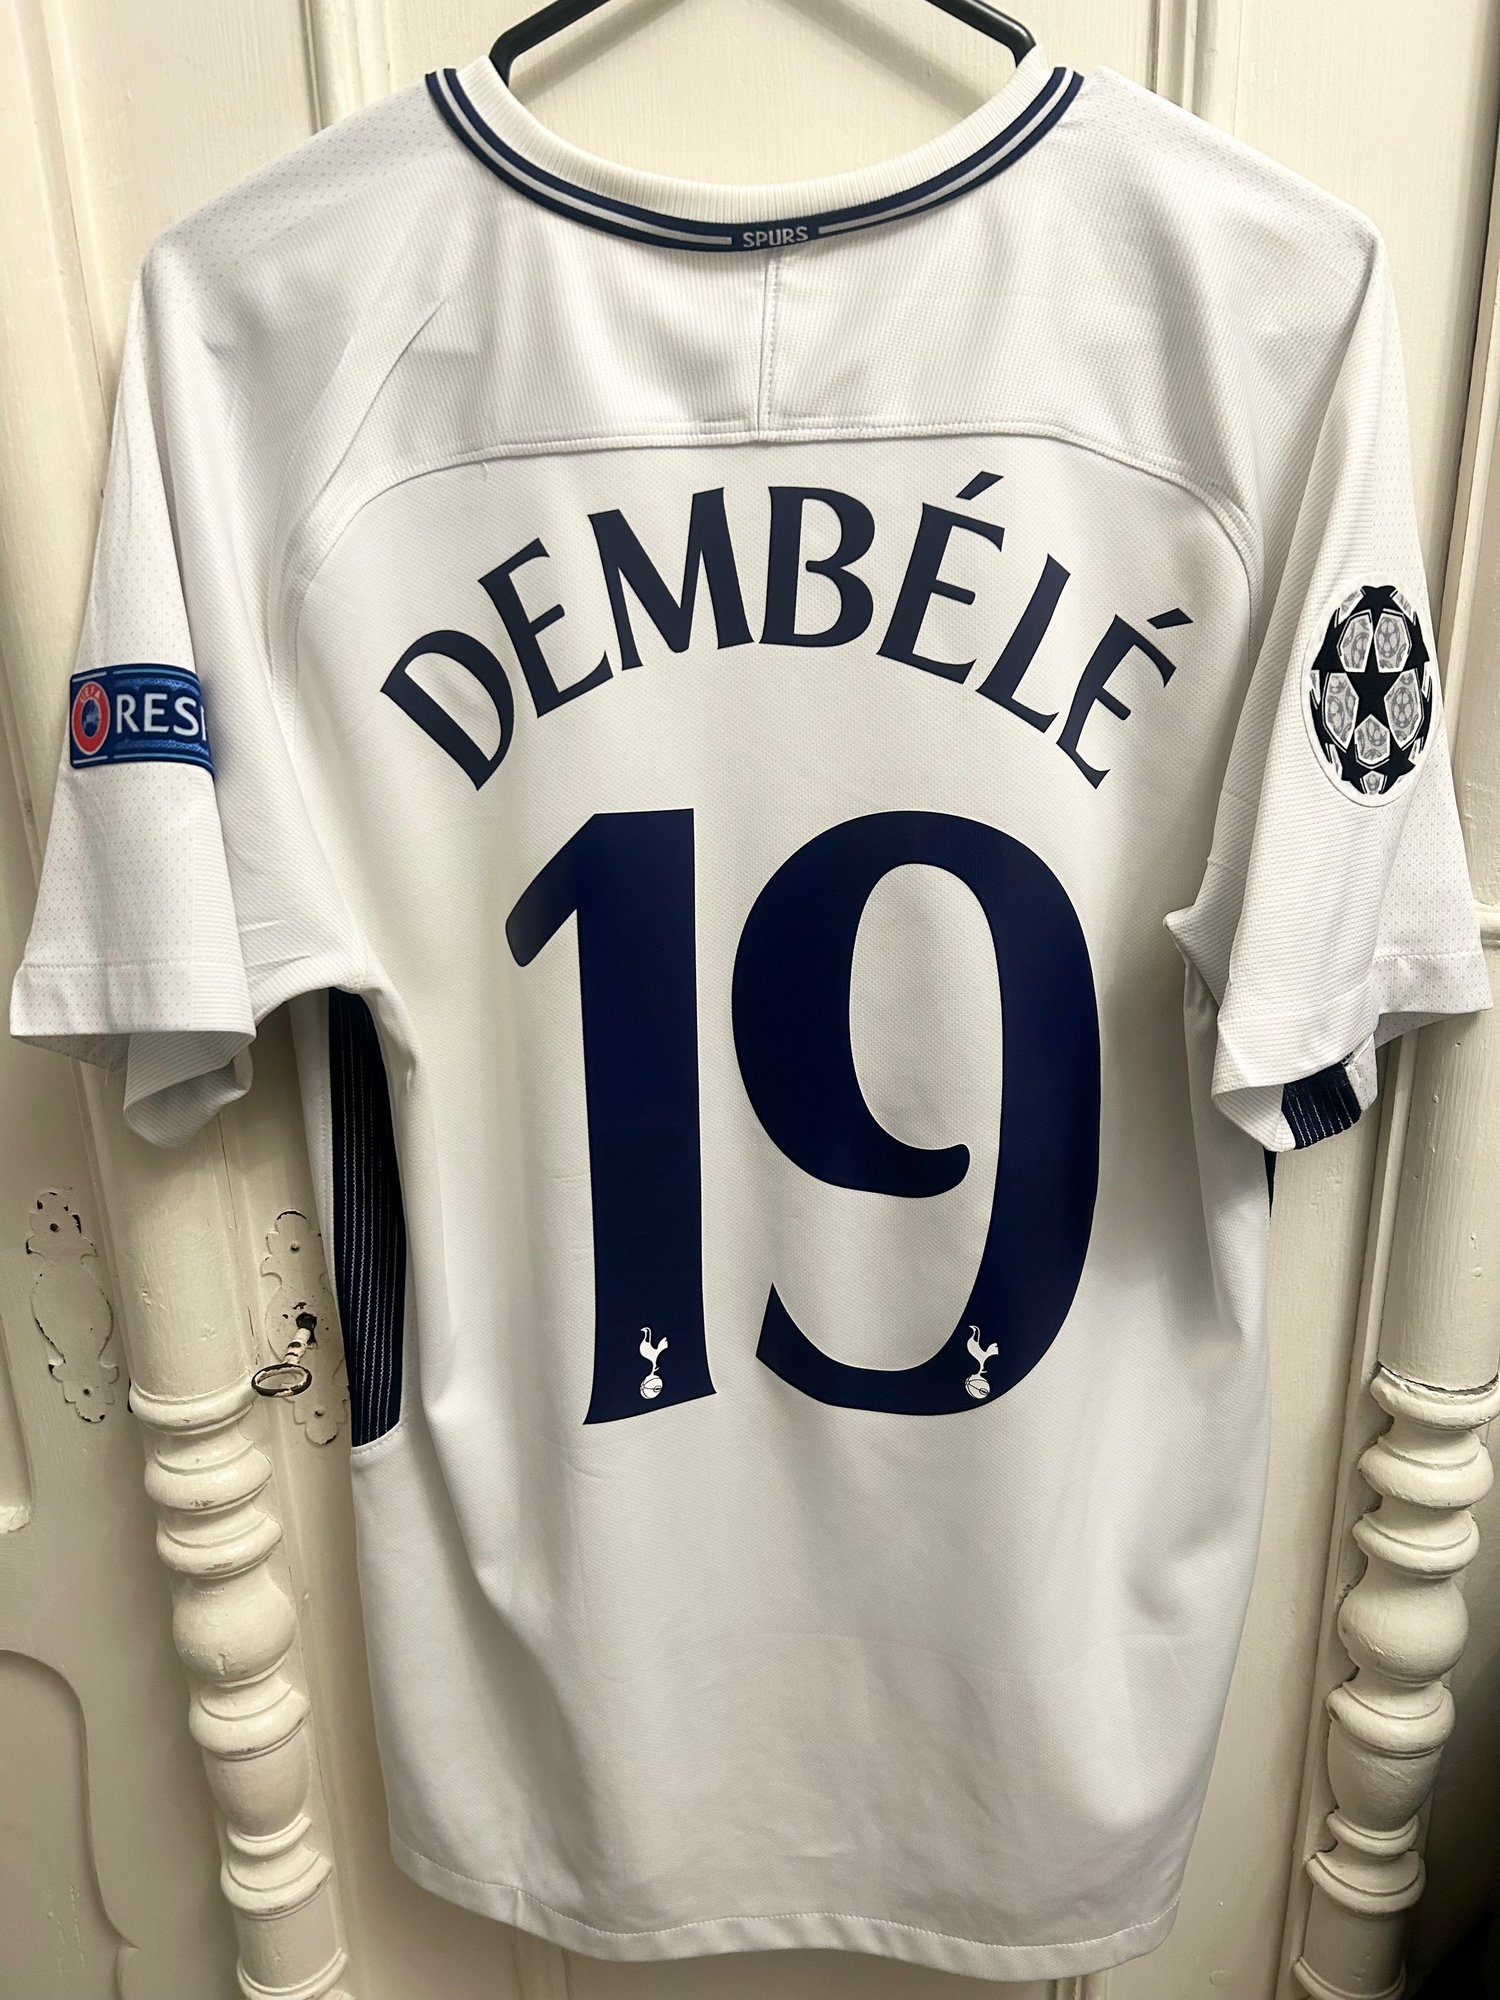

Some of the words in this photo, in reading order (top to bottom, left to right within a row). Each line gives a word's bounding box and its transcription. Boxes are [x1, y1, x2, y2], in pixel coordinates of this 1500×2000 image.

[743, 226, 809, 248] SPURS
[79, 687, 103, 703] UEFA
[381, 472, 1193, 790] DEMBÉLÉ
[506, 810, 1101, 1424] 19
